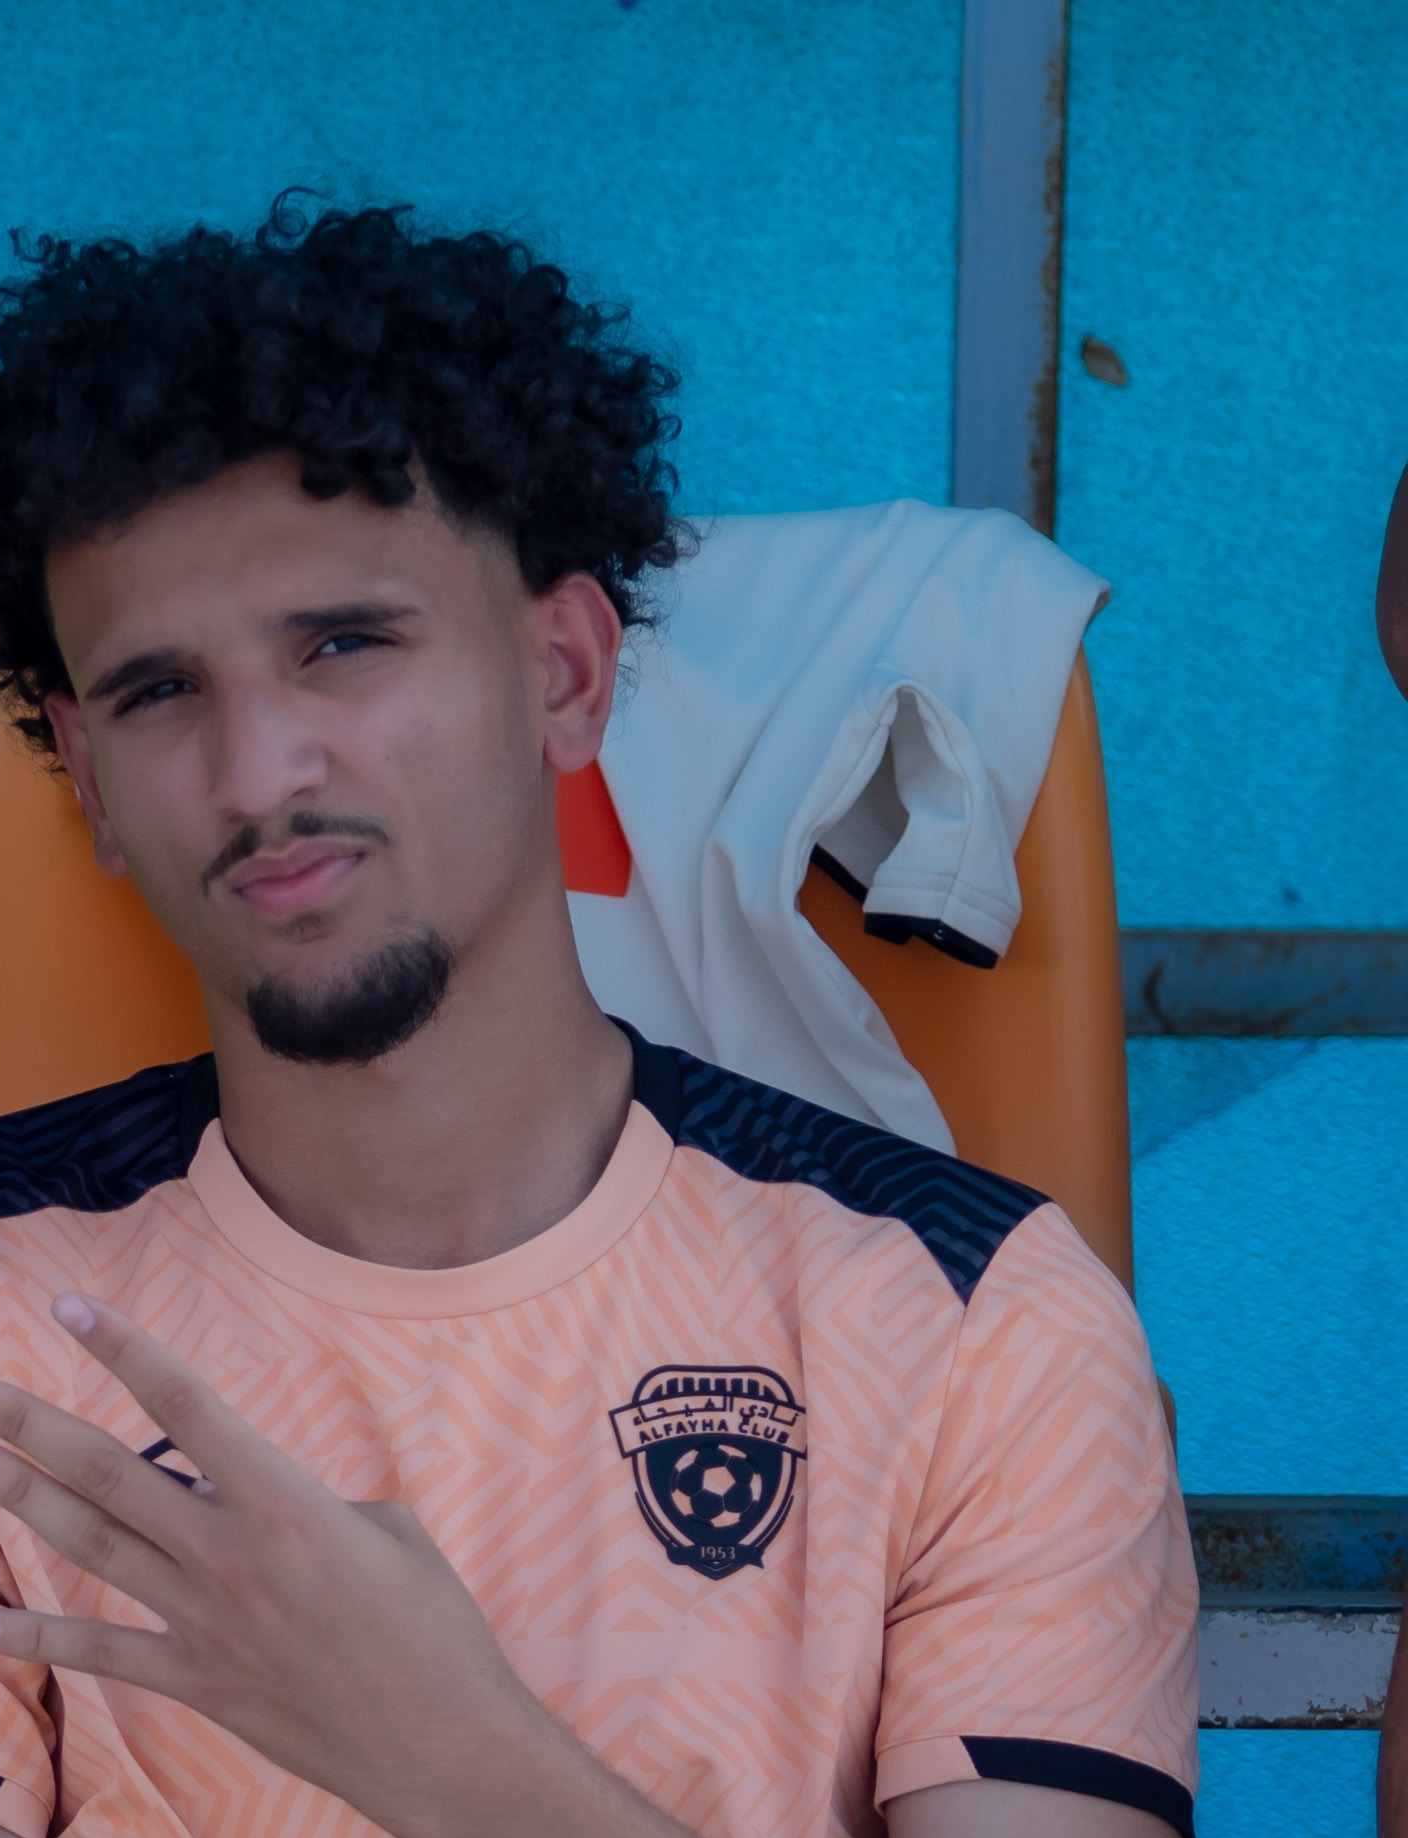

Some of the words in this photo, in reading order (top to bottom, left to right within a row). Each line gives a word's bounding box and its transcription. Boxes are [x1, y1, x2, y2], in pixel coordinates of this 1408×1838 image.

[638, 1418, 730, 1445] ALFAYHA
[737, 1422, 790, 1445] CLUB
[699, 1545, 737, 1560] 1953
